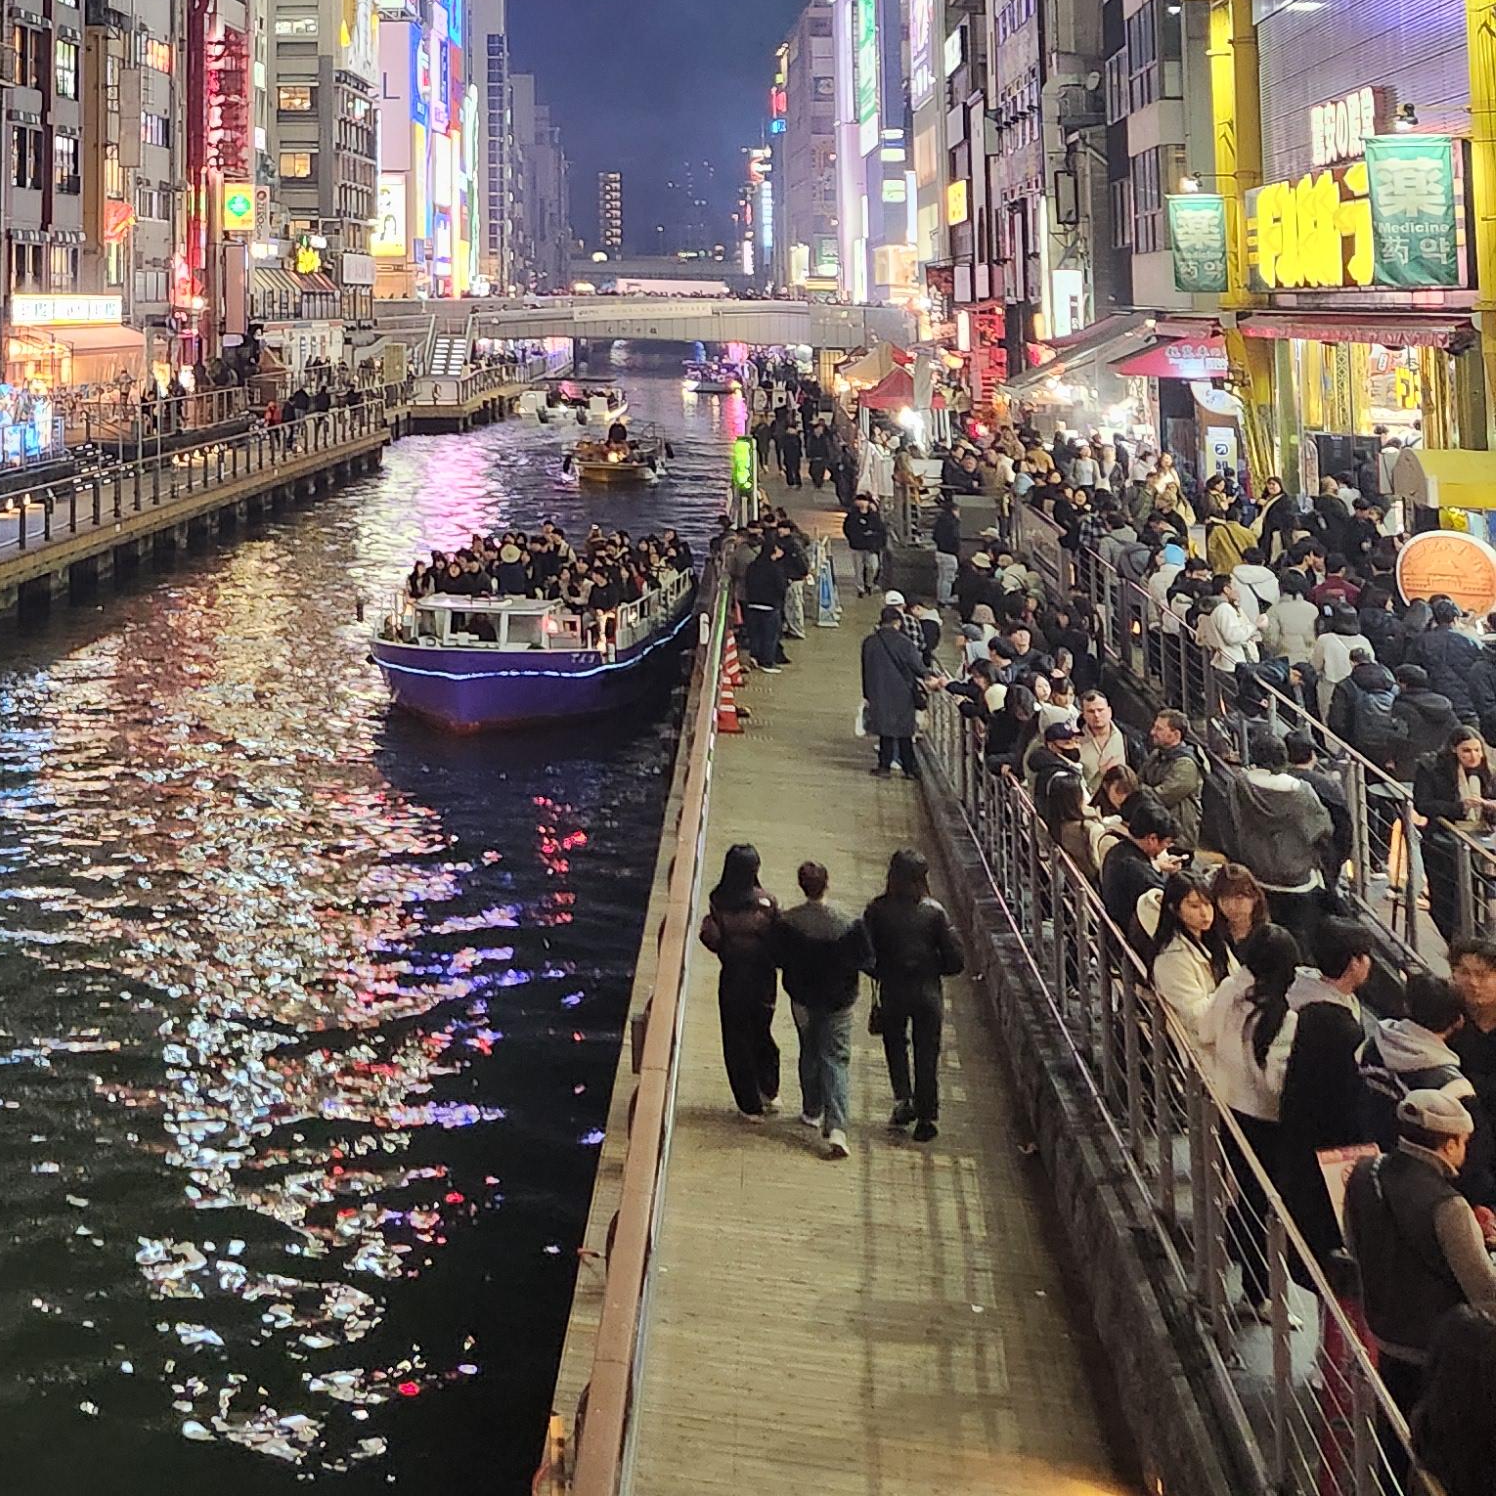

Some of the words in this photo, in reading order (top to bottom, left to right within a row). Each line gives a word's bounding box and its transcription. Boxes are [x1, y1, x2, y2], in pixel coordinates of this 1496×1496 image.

[1374, 157, 1447, 217] 薬
[1176, 209, 1222, 251] 薬
[1378, 221, 1450, 234] Medicine
[1380, 235, 1409, 265] 药
[1419, 235, 1452, 265] 약
